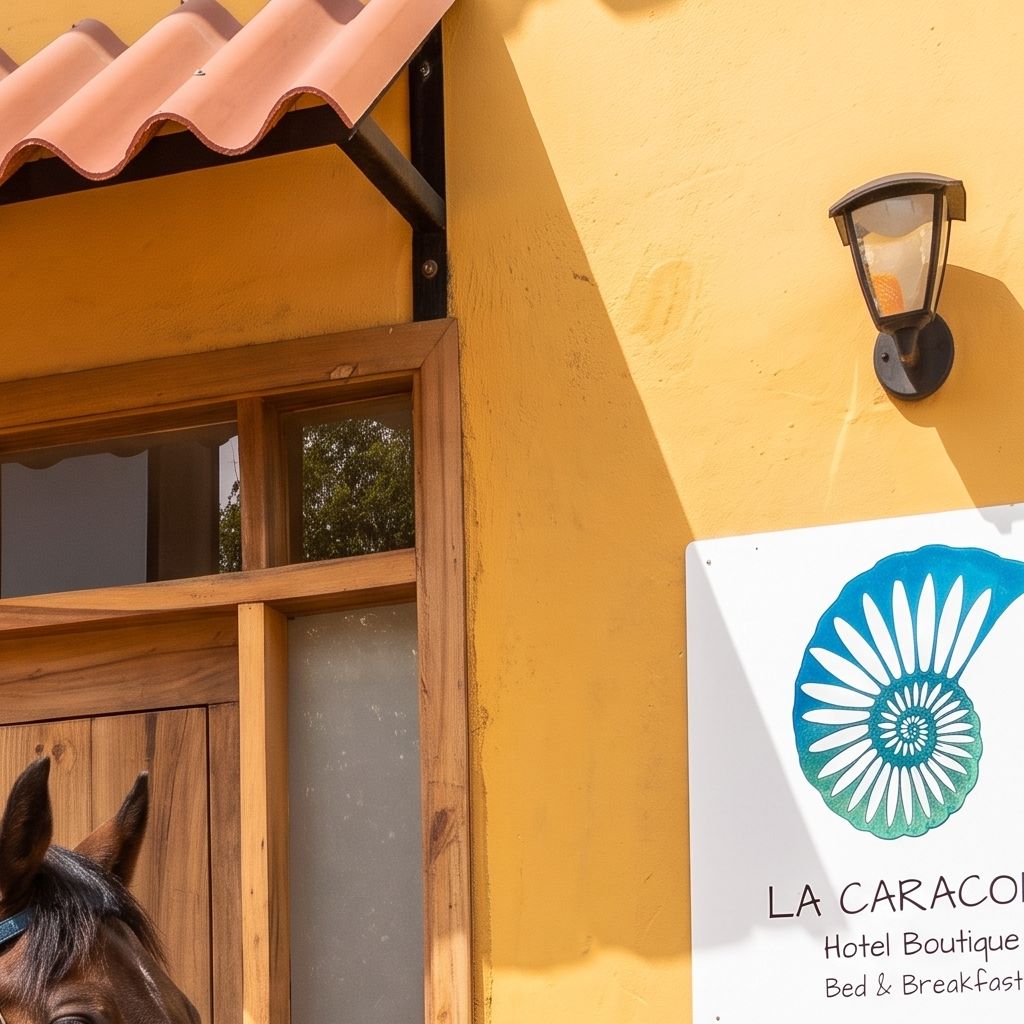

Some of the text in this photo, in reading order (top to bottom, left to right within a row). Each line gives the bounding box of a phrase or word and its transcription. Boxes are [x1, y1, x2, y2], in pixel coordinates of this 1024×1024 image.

[768, 871, 1024, 919] LA CARACO
[824, 929, 1020, 963] Hotel Boutique
[825, 967, 1023, 998] Bed & Breakfast
